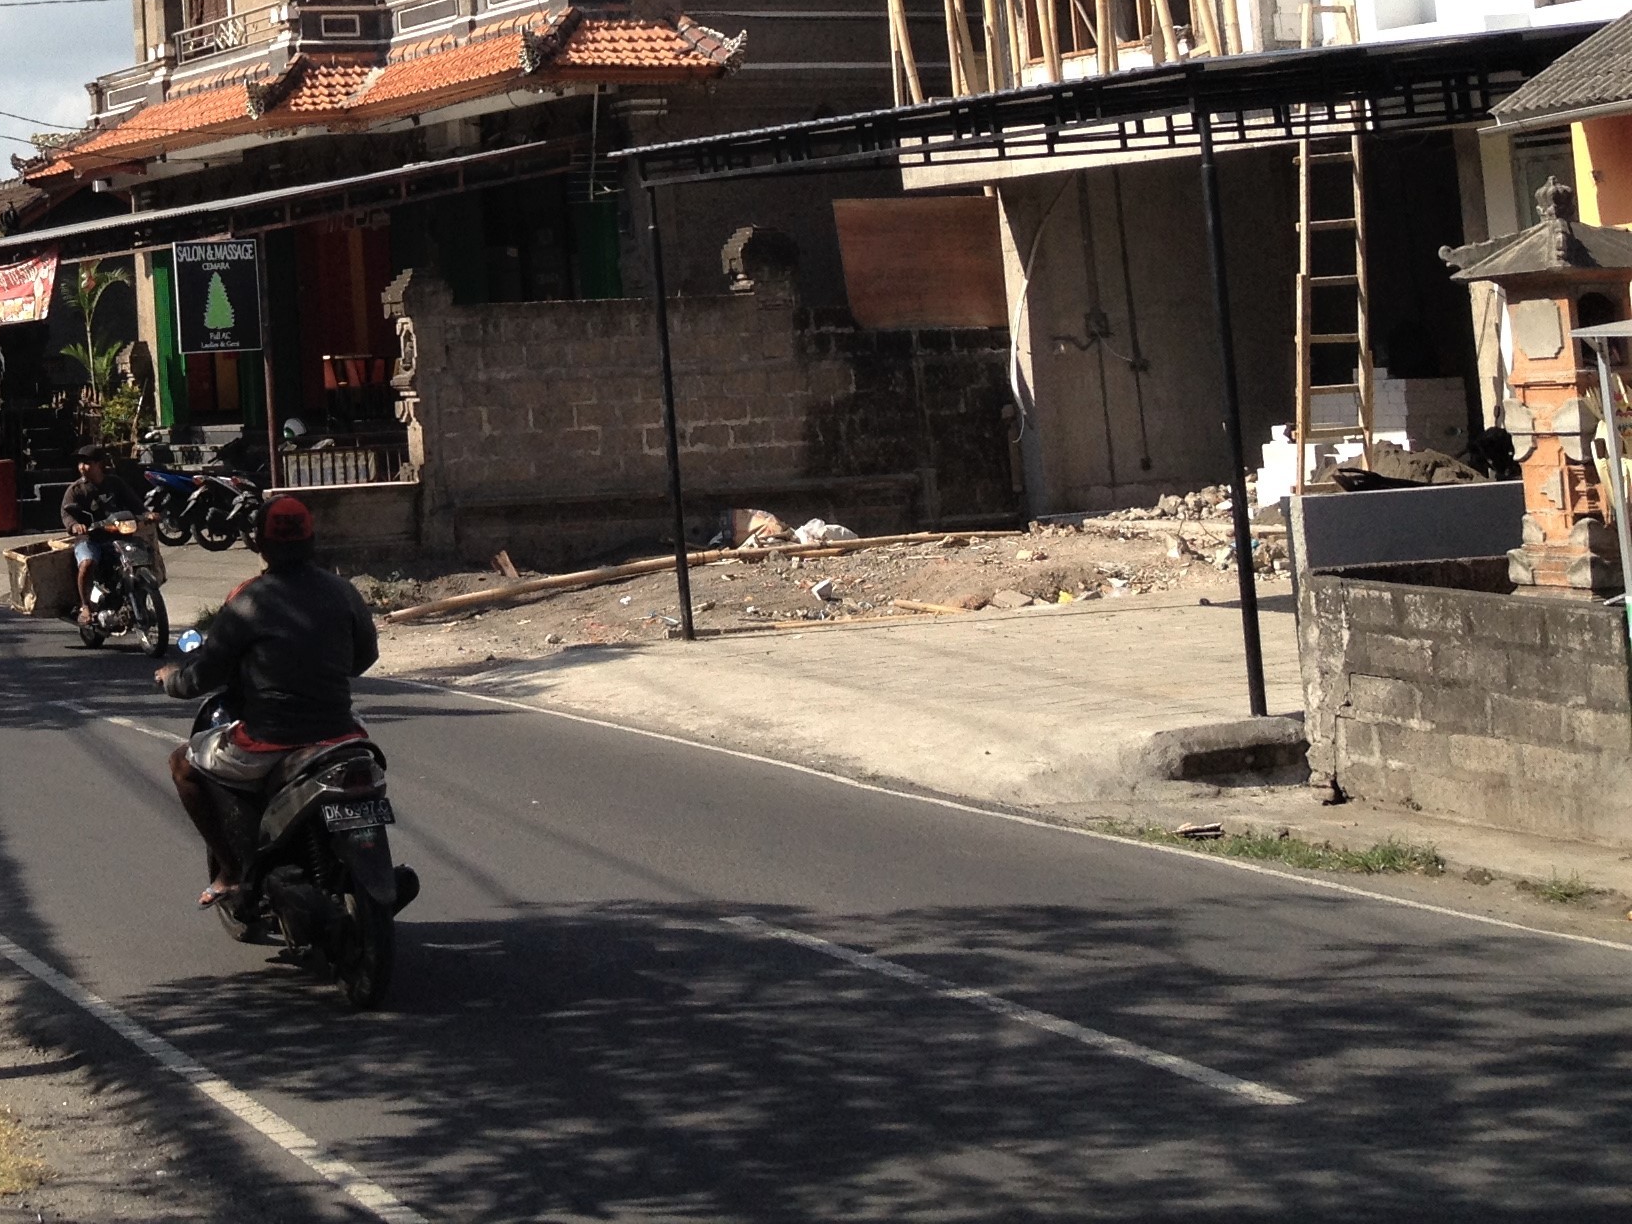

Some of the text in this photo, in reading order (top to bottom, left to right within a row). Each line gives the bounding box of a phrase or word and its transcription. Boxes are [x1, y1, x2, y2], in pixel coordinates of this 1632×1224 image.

[177, 245, 206, 262] SALON
[214, 244, 254, 260] MASSAGE
[325, 805, 343, 820] DK
